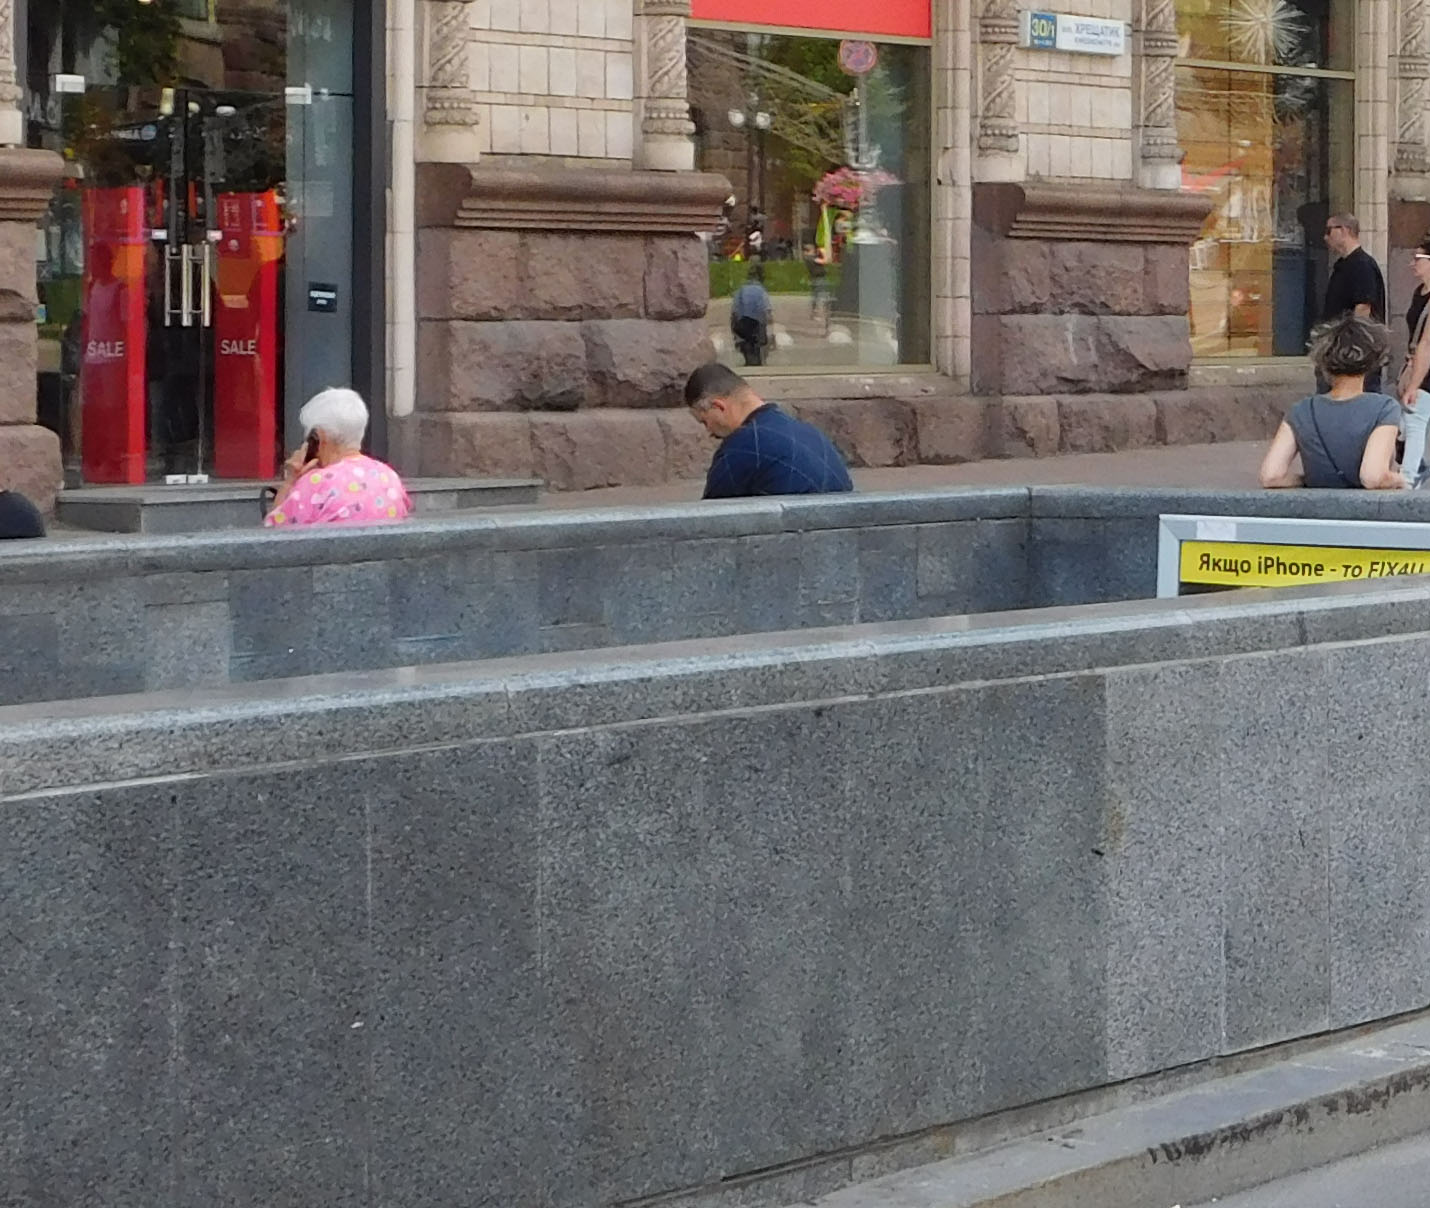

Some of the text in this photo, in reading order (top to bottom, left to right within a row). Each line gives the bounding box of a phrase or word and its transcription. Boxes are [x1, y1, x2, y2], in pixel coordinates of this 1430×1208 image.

[87, 340, 124, 358] SALE
[221, 339, 256, 355] SALE
[1198, 553, 1251, 576] Якщо
[1257, 555, 1324, 577] iPhone
[1342, 564, 1362, 578] то
